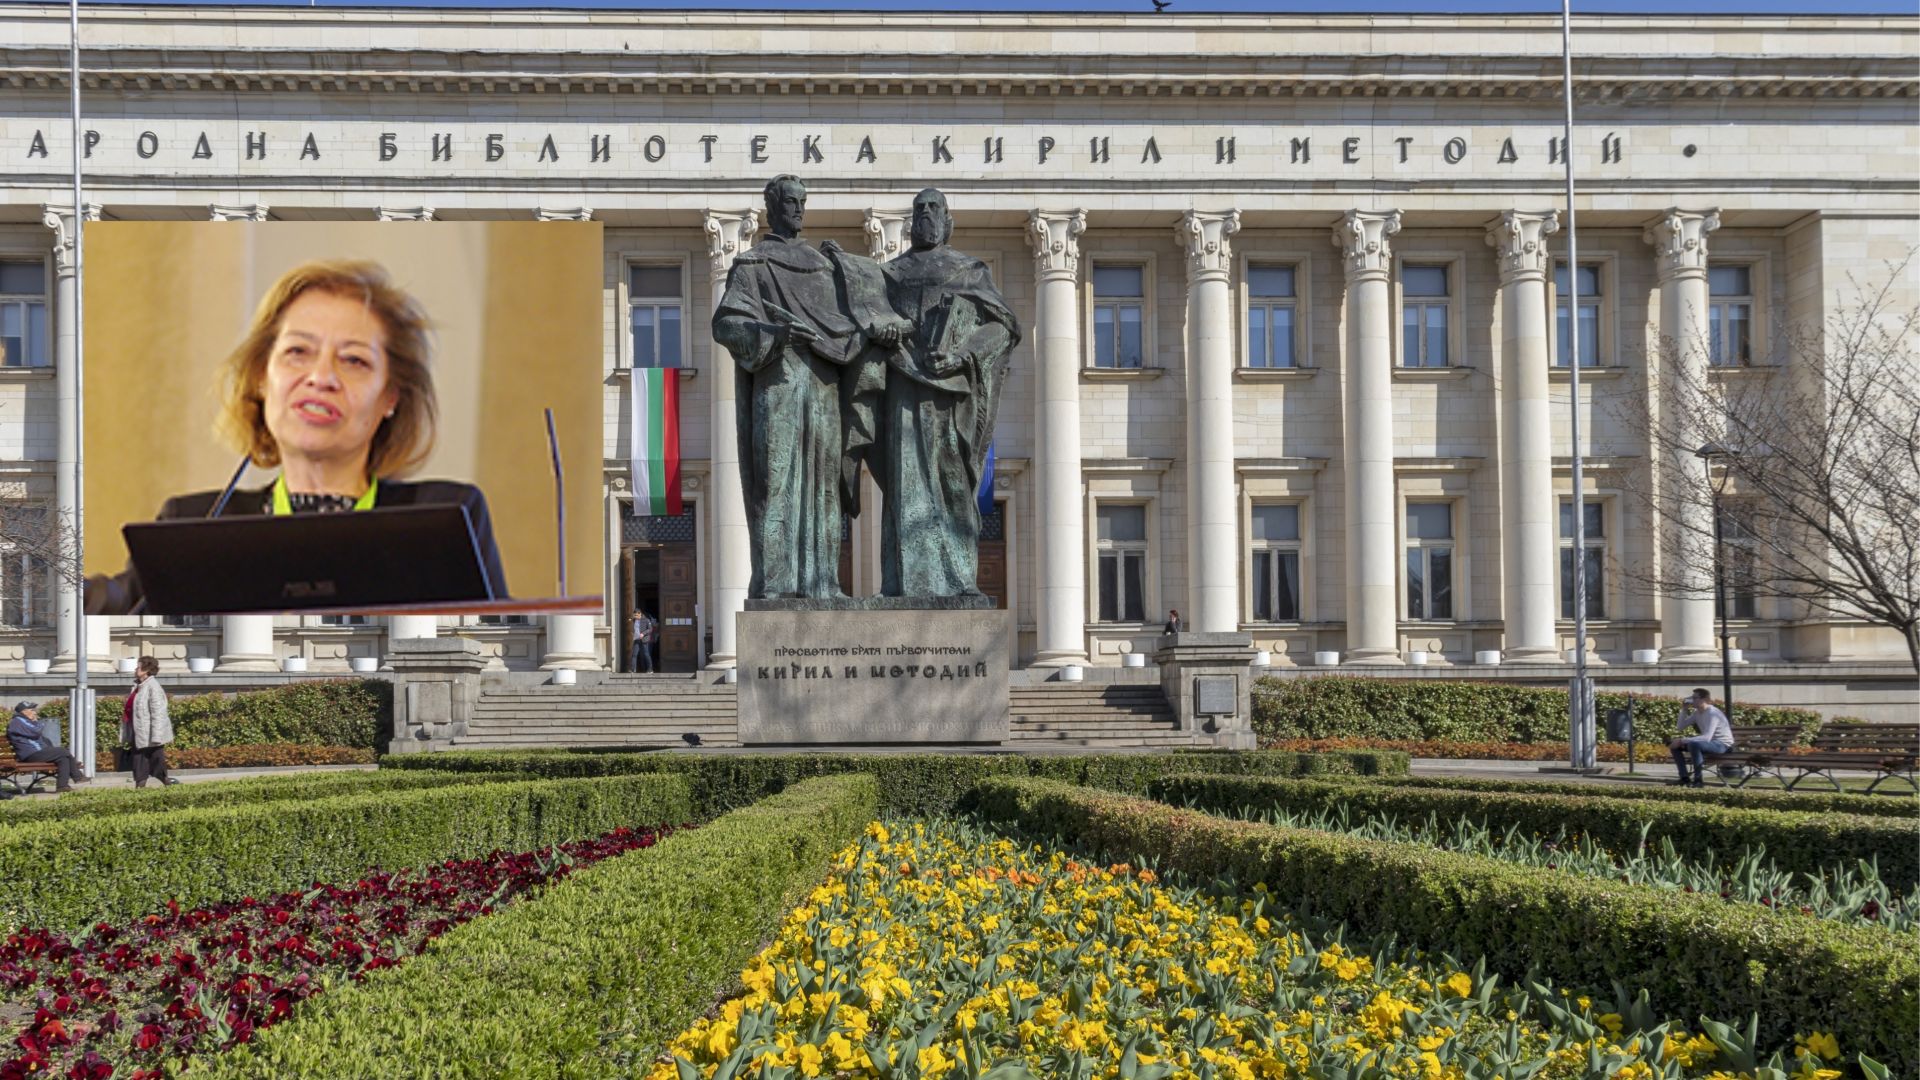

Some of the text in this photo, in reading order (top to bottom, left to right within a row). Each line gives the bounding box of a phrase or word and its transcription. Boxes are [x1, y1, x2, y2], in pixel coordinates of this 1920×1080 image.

[378, 132, 877, 165] БИБЛИОТЕКА
[931, 135, 1162, 165] КИРИЛ
[1215, 136, 1238, 165] И
[1290, 131, 1622, 165] МЕТОДИЙ
[758, 662, 833, 680] КИРИЛ
[844, 666, 858, 680] И
